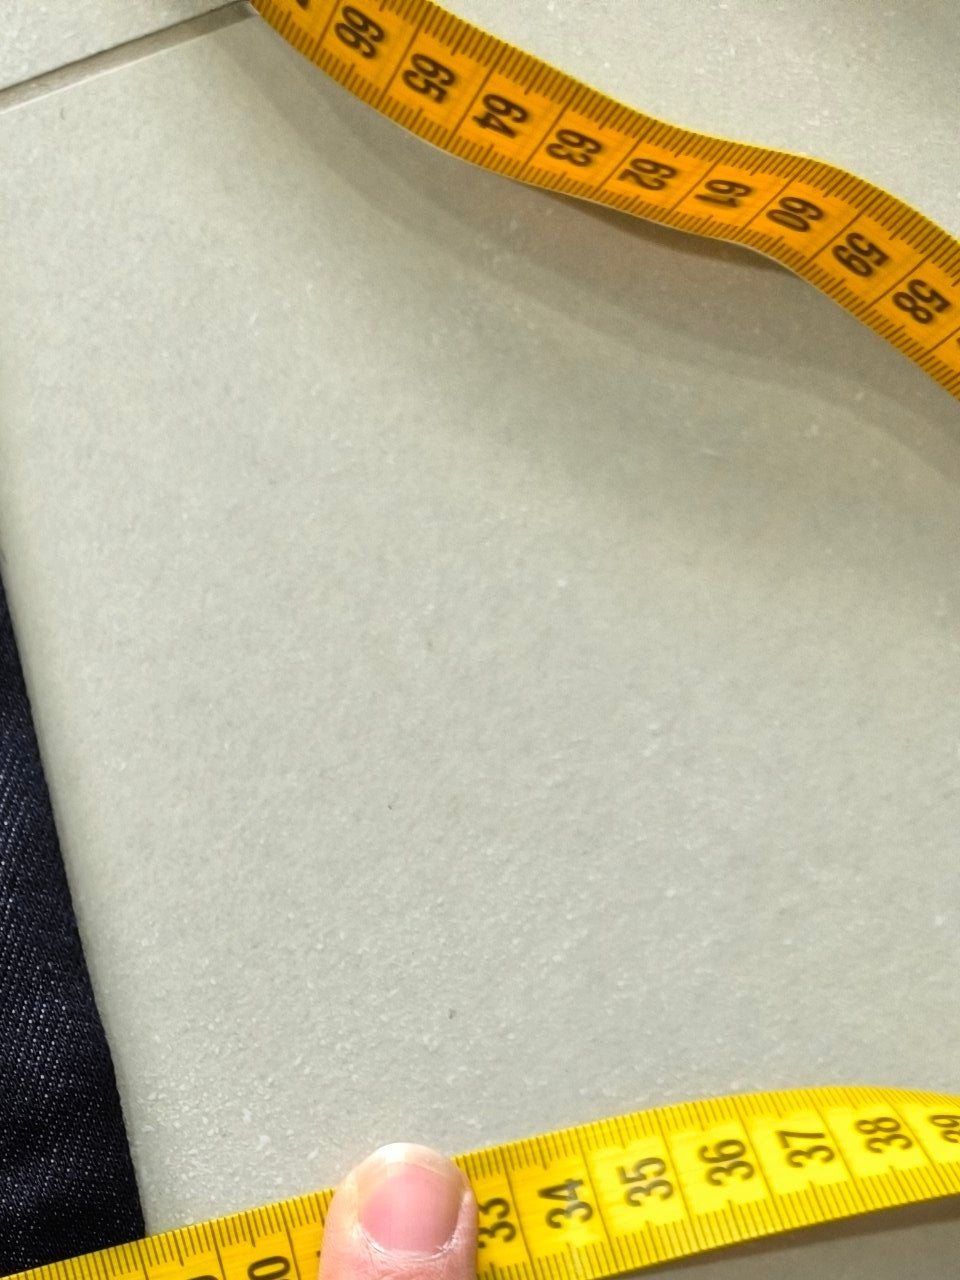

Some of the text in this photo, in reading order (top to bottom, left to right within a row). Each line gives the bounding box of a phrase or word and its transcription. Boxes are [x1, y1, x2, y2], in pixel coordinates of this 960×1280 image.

[334, 5, 386, 60] 66
[402, 52, 457, 103] 65
[472, 92, 528, 139] 64
[546, 127, 602, 168] 63
[620, 156, 678, 191] 62
[695, 178, 752, 209] 61
[767, 195, 824, 233] 60
[832, 231, 890, 278] 59
[892, 278, 950, 325] 58
[778, 1130, 835, 1169] 37
[855, 1116, 913, 1154] 38
[617, 1157, 673, 1208] 35
[697, 1139, 754, 1187] 36
[476, 1197, 517, 1249] 33
[537, 1178, 593, 1230] 34
